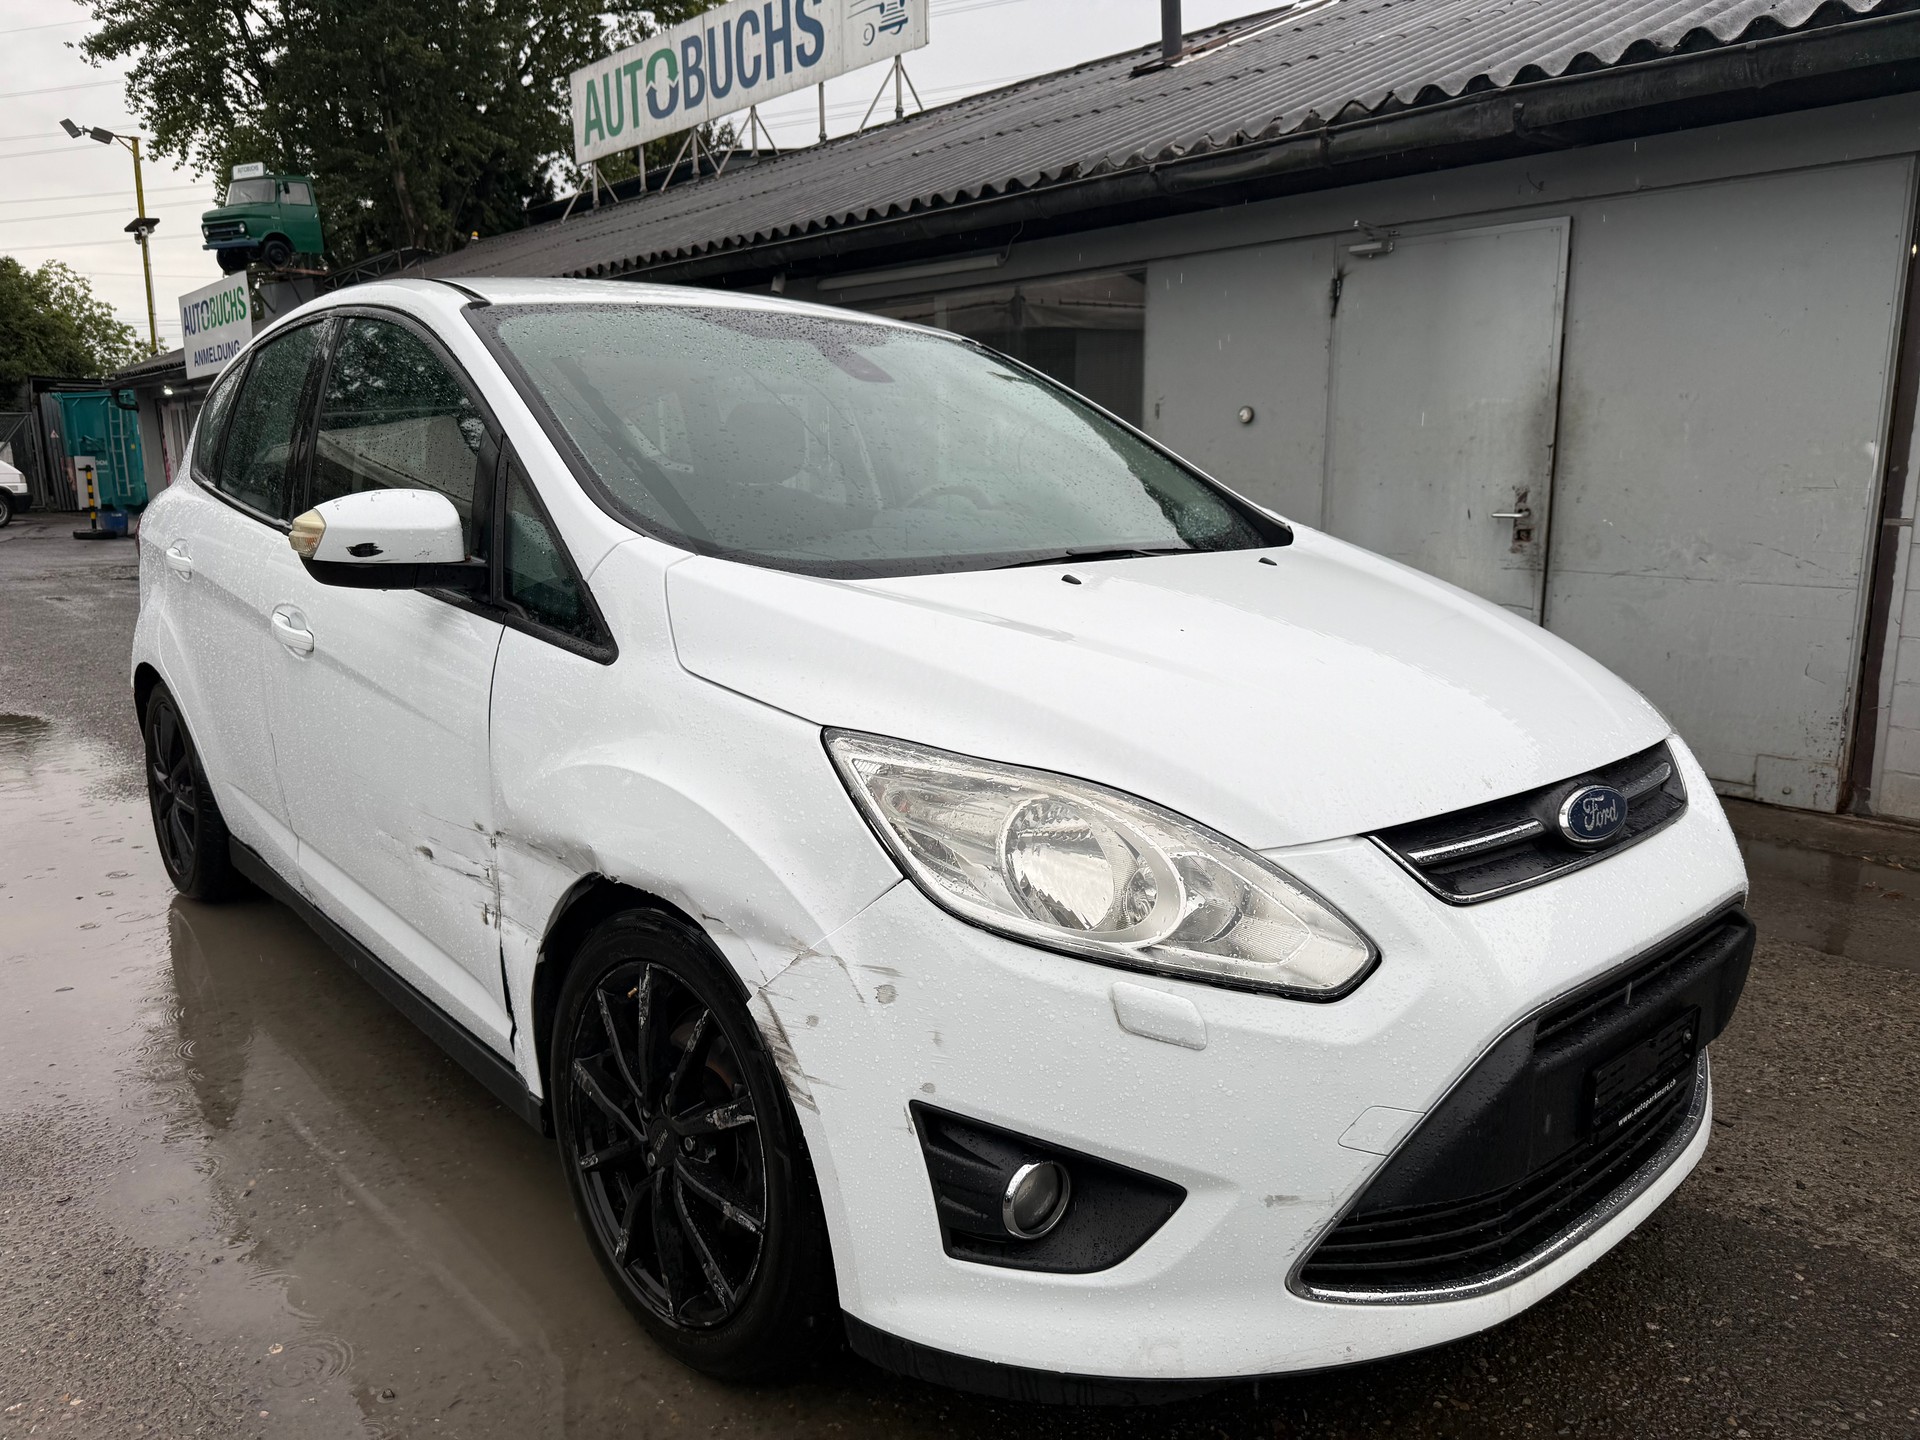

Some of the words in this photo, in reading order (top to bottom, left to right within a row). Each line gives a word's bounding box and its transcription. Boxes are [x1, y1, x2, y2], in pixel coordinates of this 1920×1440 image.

[584, 0, 825, 147] AUTOBUCHS
[183, 286, 247, 337] AUTOBUCHS
[194, 340, 240, 367] ANMELDUNG
[1582, 794, 1619, 831] Ford
